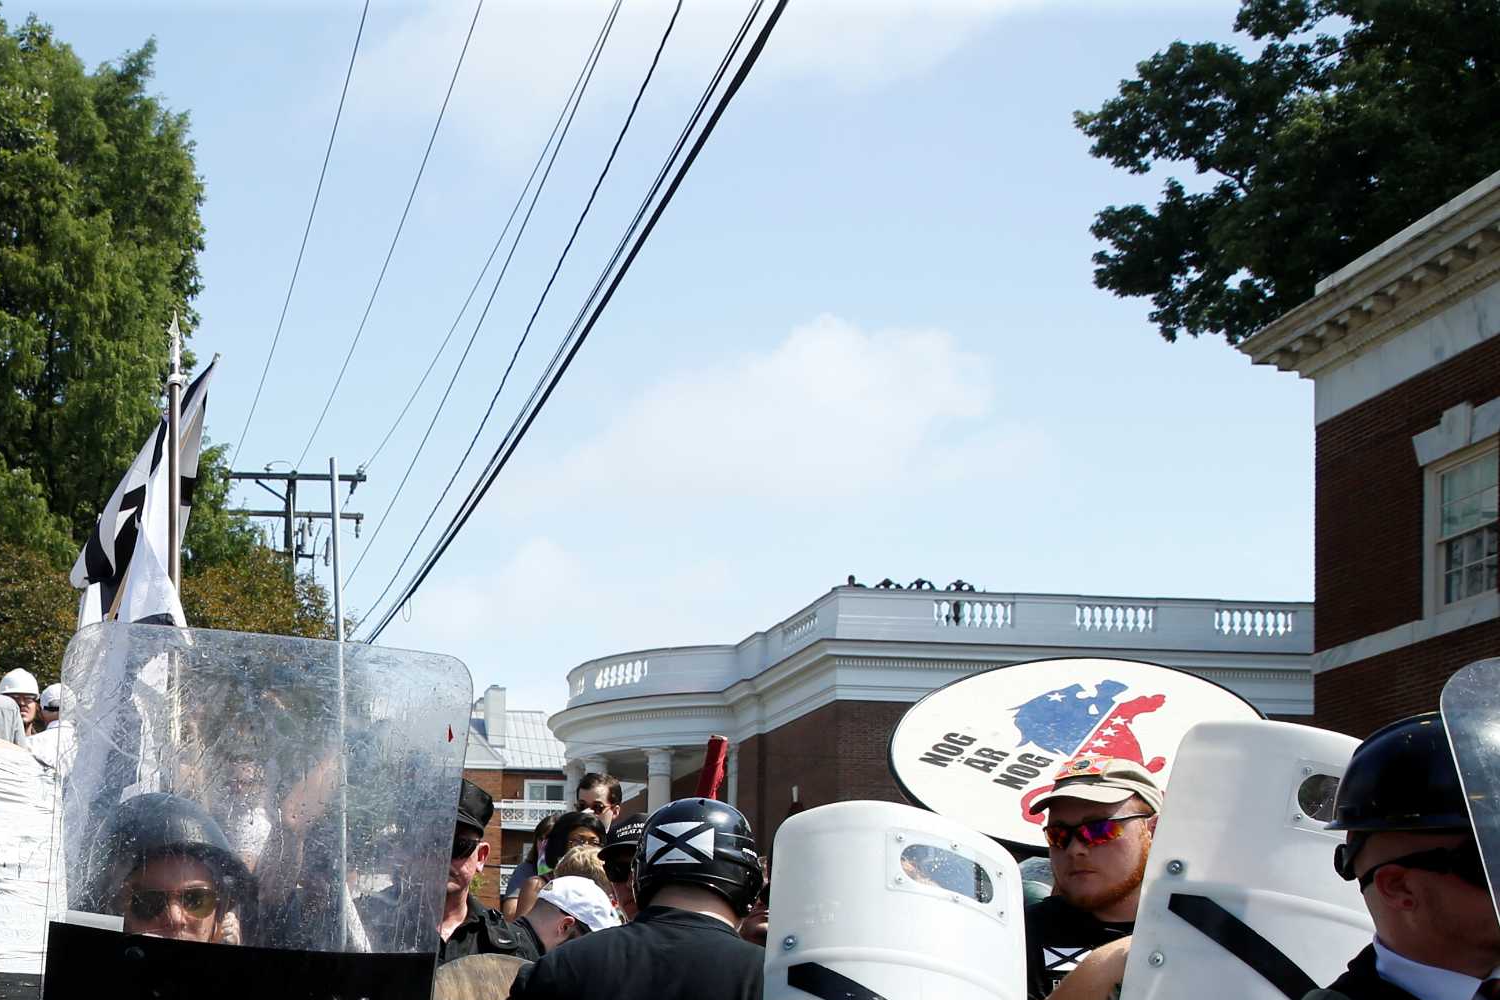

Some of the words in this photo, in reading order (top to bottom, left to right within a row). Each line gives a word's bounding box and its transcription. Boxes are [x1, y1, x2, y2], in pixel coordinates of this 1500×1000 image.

[918, 732, 977, 767] NOG
[957, 747, 1010, 773] ÄR
[992, 753, 1054, 790] NOG
